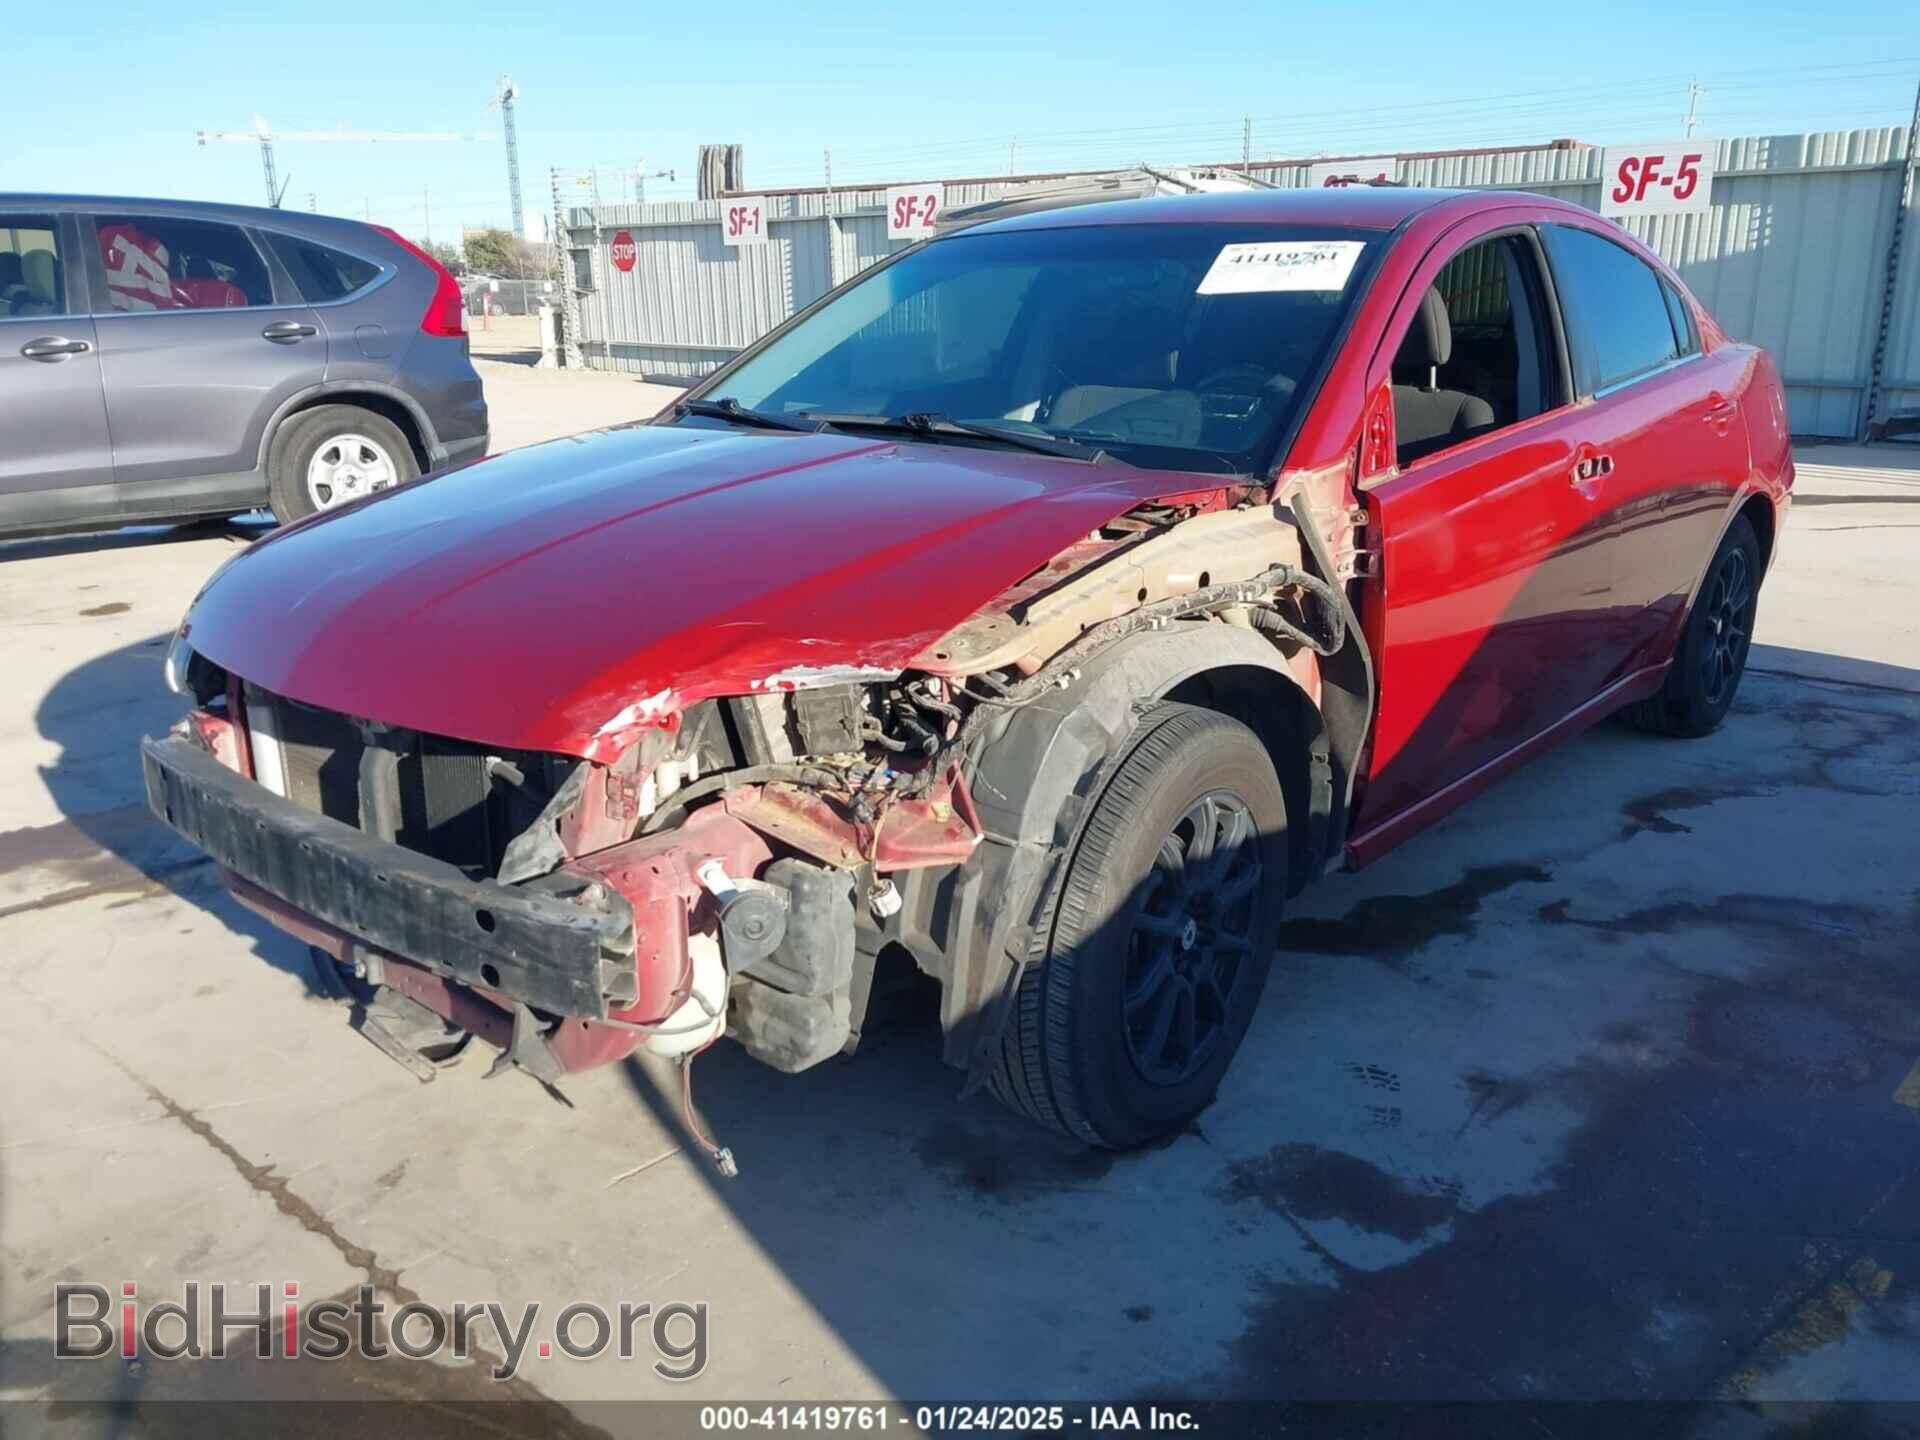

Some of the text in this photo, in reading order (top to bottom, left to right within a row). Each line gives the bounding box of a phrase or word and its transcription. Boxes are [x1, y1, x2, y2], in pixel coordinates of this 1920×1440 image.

[1612, 153, 1702, 203] SF-5
[729, 206, 759, 236] SF-1
[894, 194, 936, 229] SF-2
[613, 244, 635, 260] STOP
